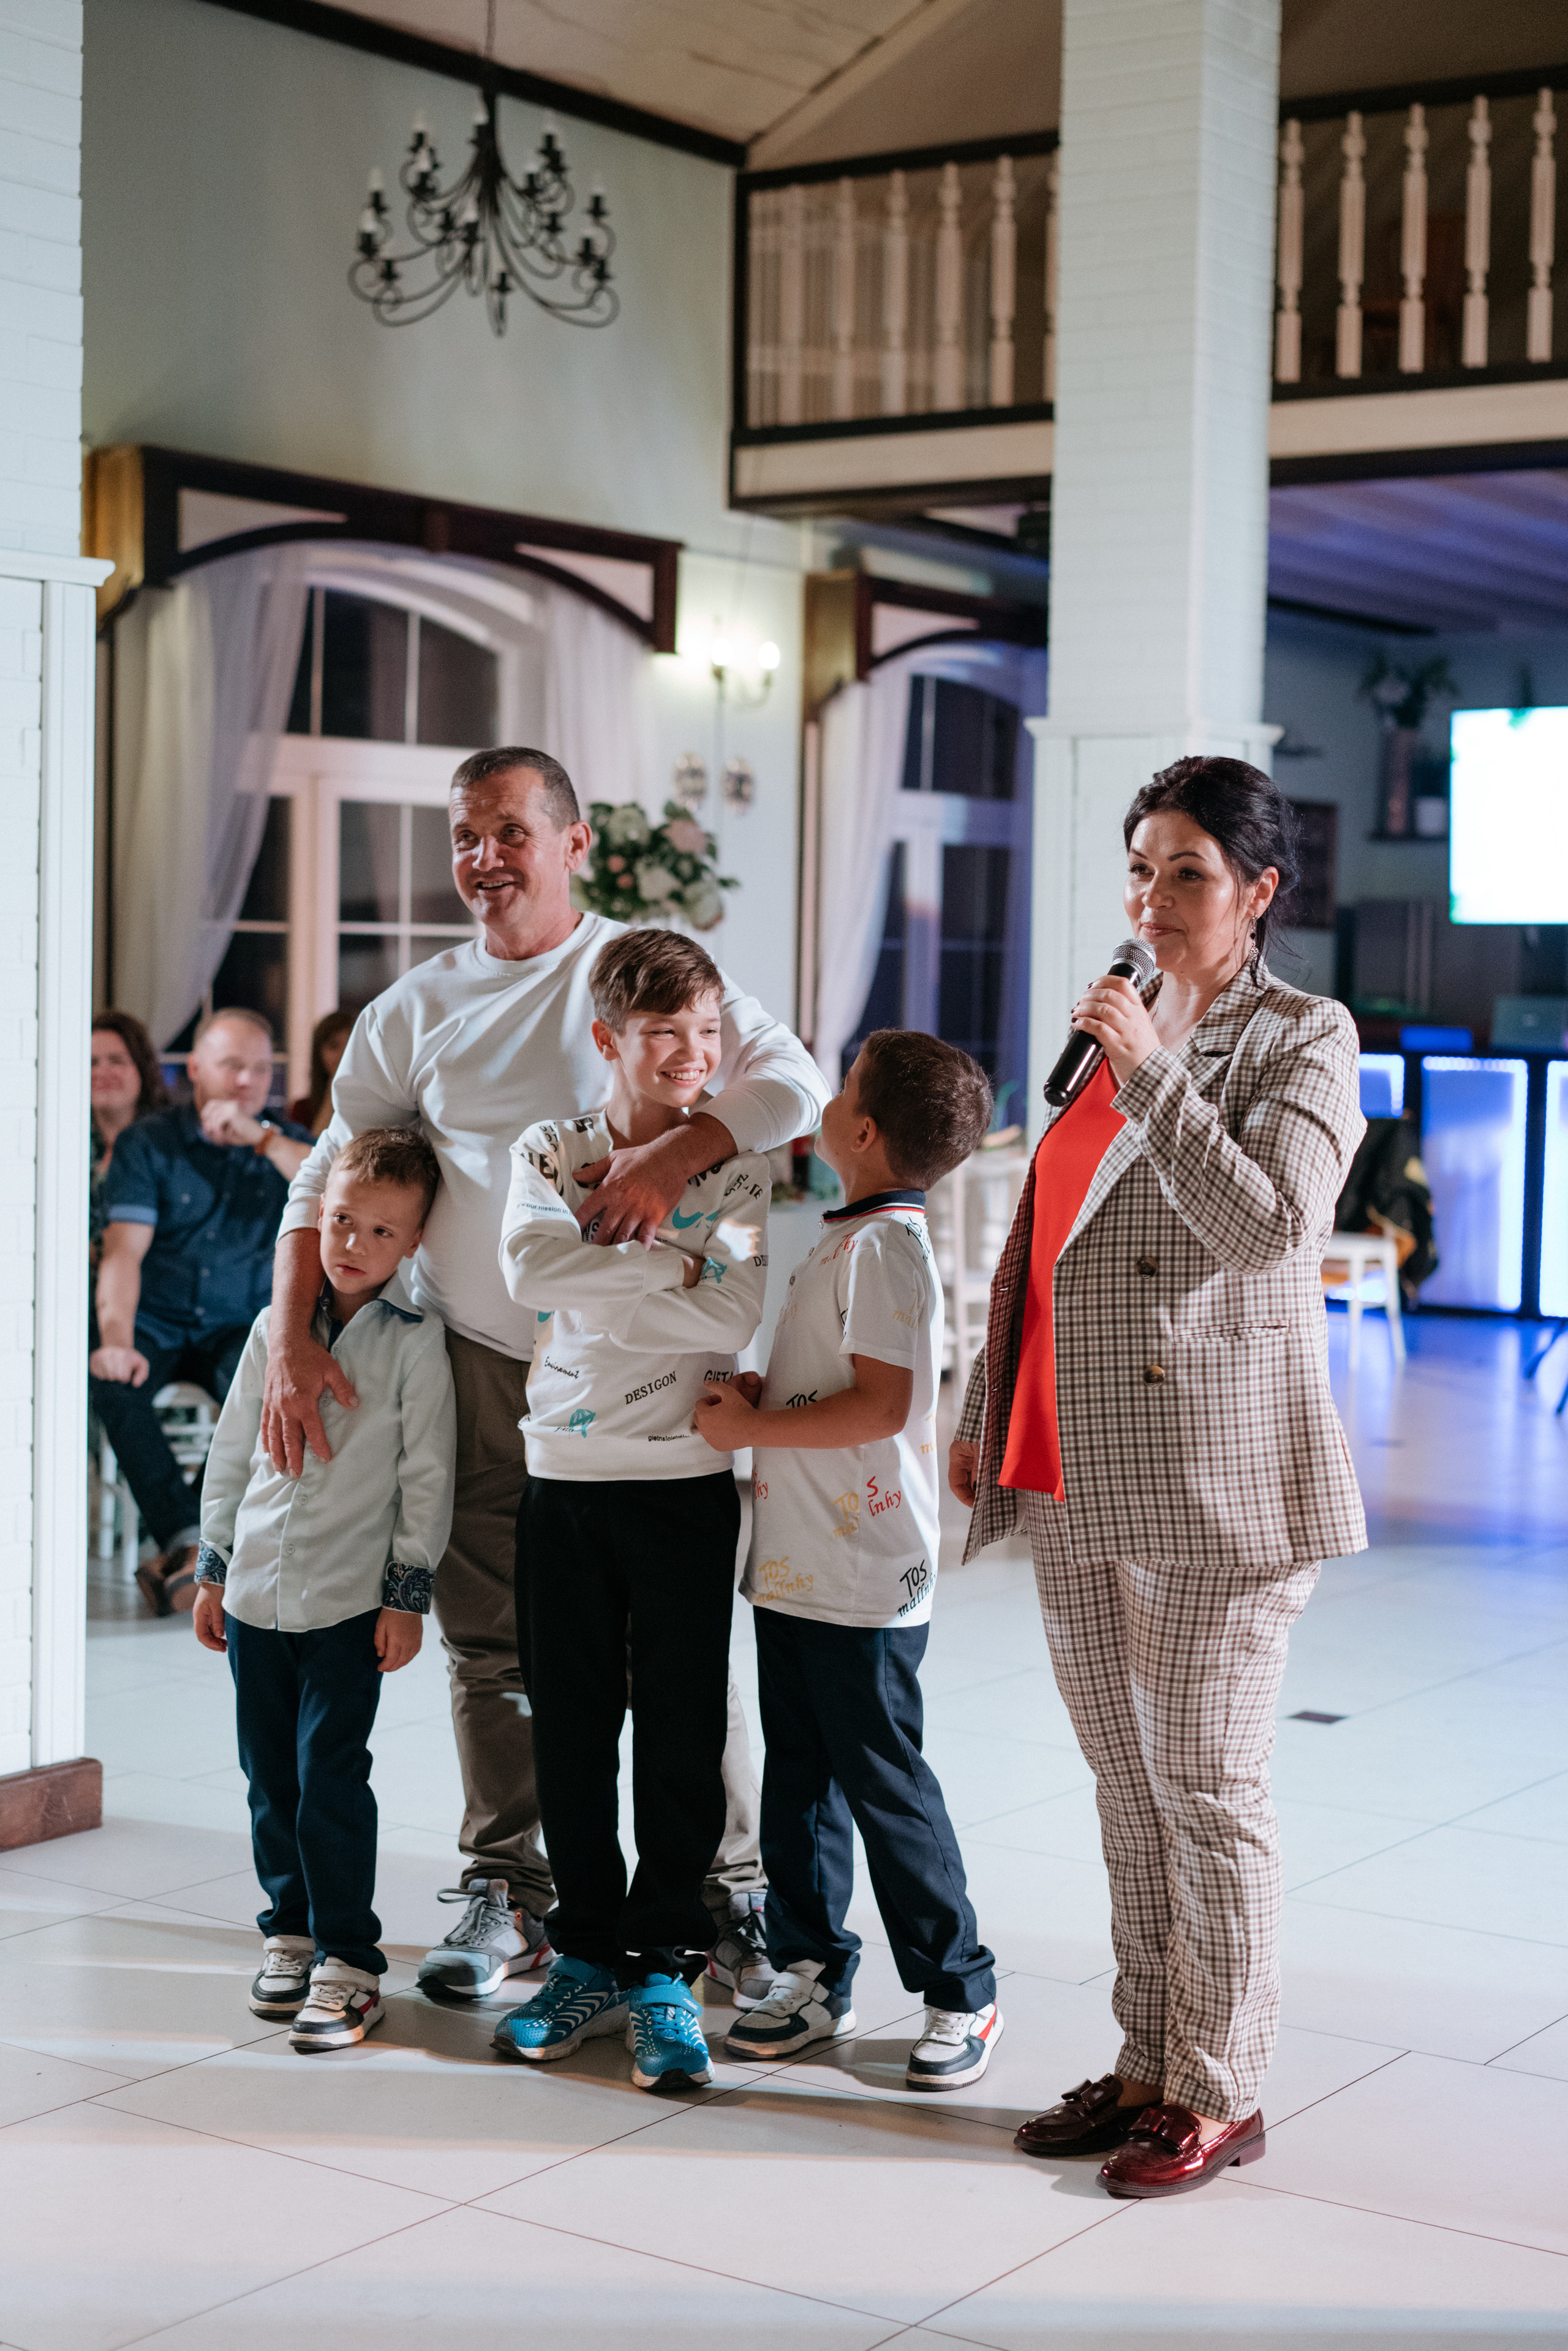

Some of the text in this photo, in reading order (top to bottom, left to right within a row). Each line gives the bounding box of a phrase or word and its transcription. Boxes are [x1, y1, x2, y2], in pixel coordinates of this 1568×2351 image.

[624, 1371, 677, 1405] DESIGON
[760, 1557, 790, 1590] TOS
[899, 1559, 924, 1598] TOS
